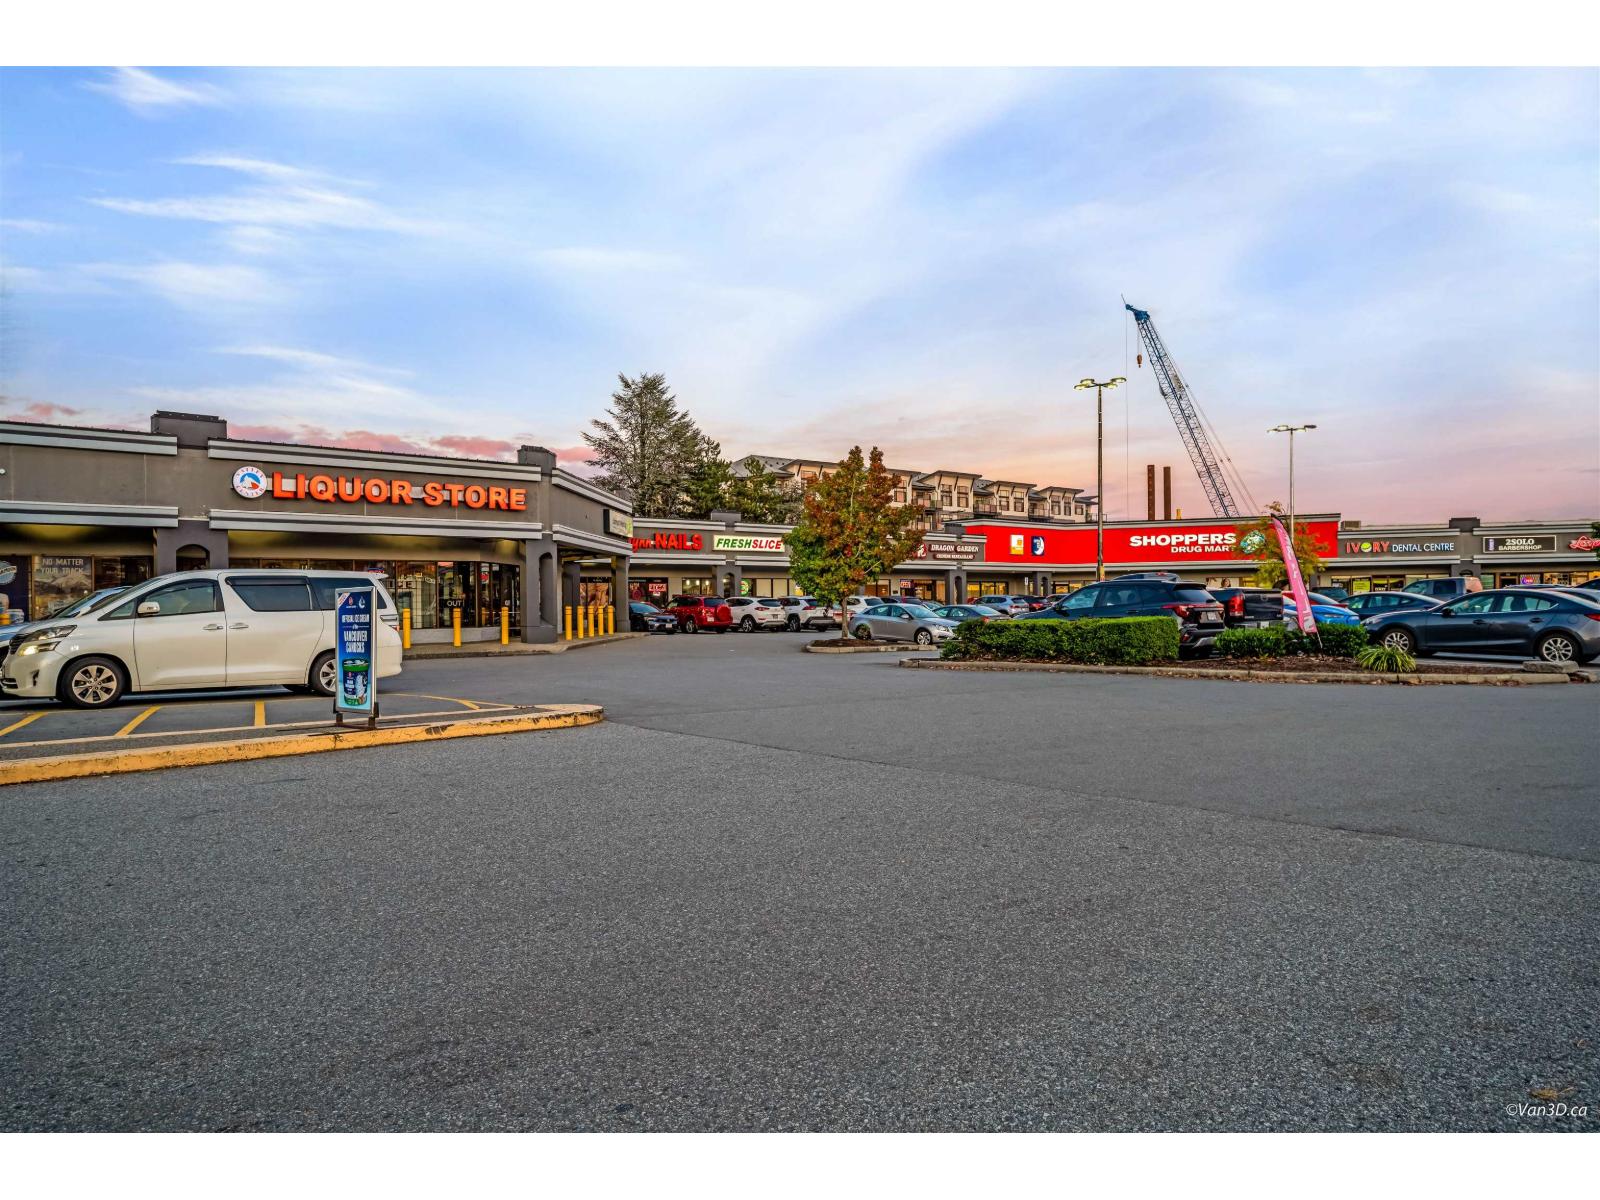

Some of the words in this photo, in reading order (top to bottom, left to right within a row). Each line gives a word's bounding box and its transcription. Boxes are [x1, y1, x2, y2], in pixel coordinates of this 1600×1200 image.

[272, 471, 412, 505] LIQUOR
[423, 482, 527, 511] STORE
[654, 533, 704, 550] NAILS
[716, 538, 783, 550] FRESHSLICE
[1129, 533, 1237, 546] SHOPPERS
[931, 544, 955, 552] DRAGON
[957, 545, 979, 553] GARDEN
[1171, 545, 1202, 553] DRUG
[1346, 541, 1390, 554] IVORY
[1392, 544, 1422, 552] DENTAL
[1423, 543, 1455, 552] CENTRE
[41, 567, 58, 575] YOUR
[343, 630, 368, 642] VANCOUVER
